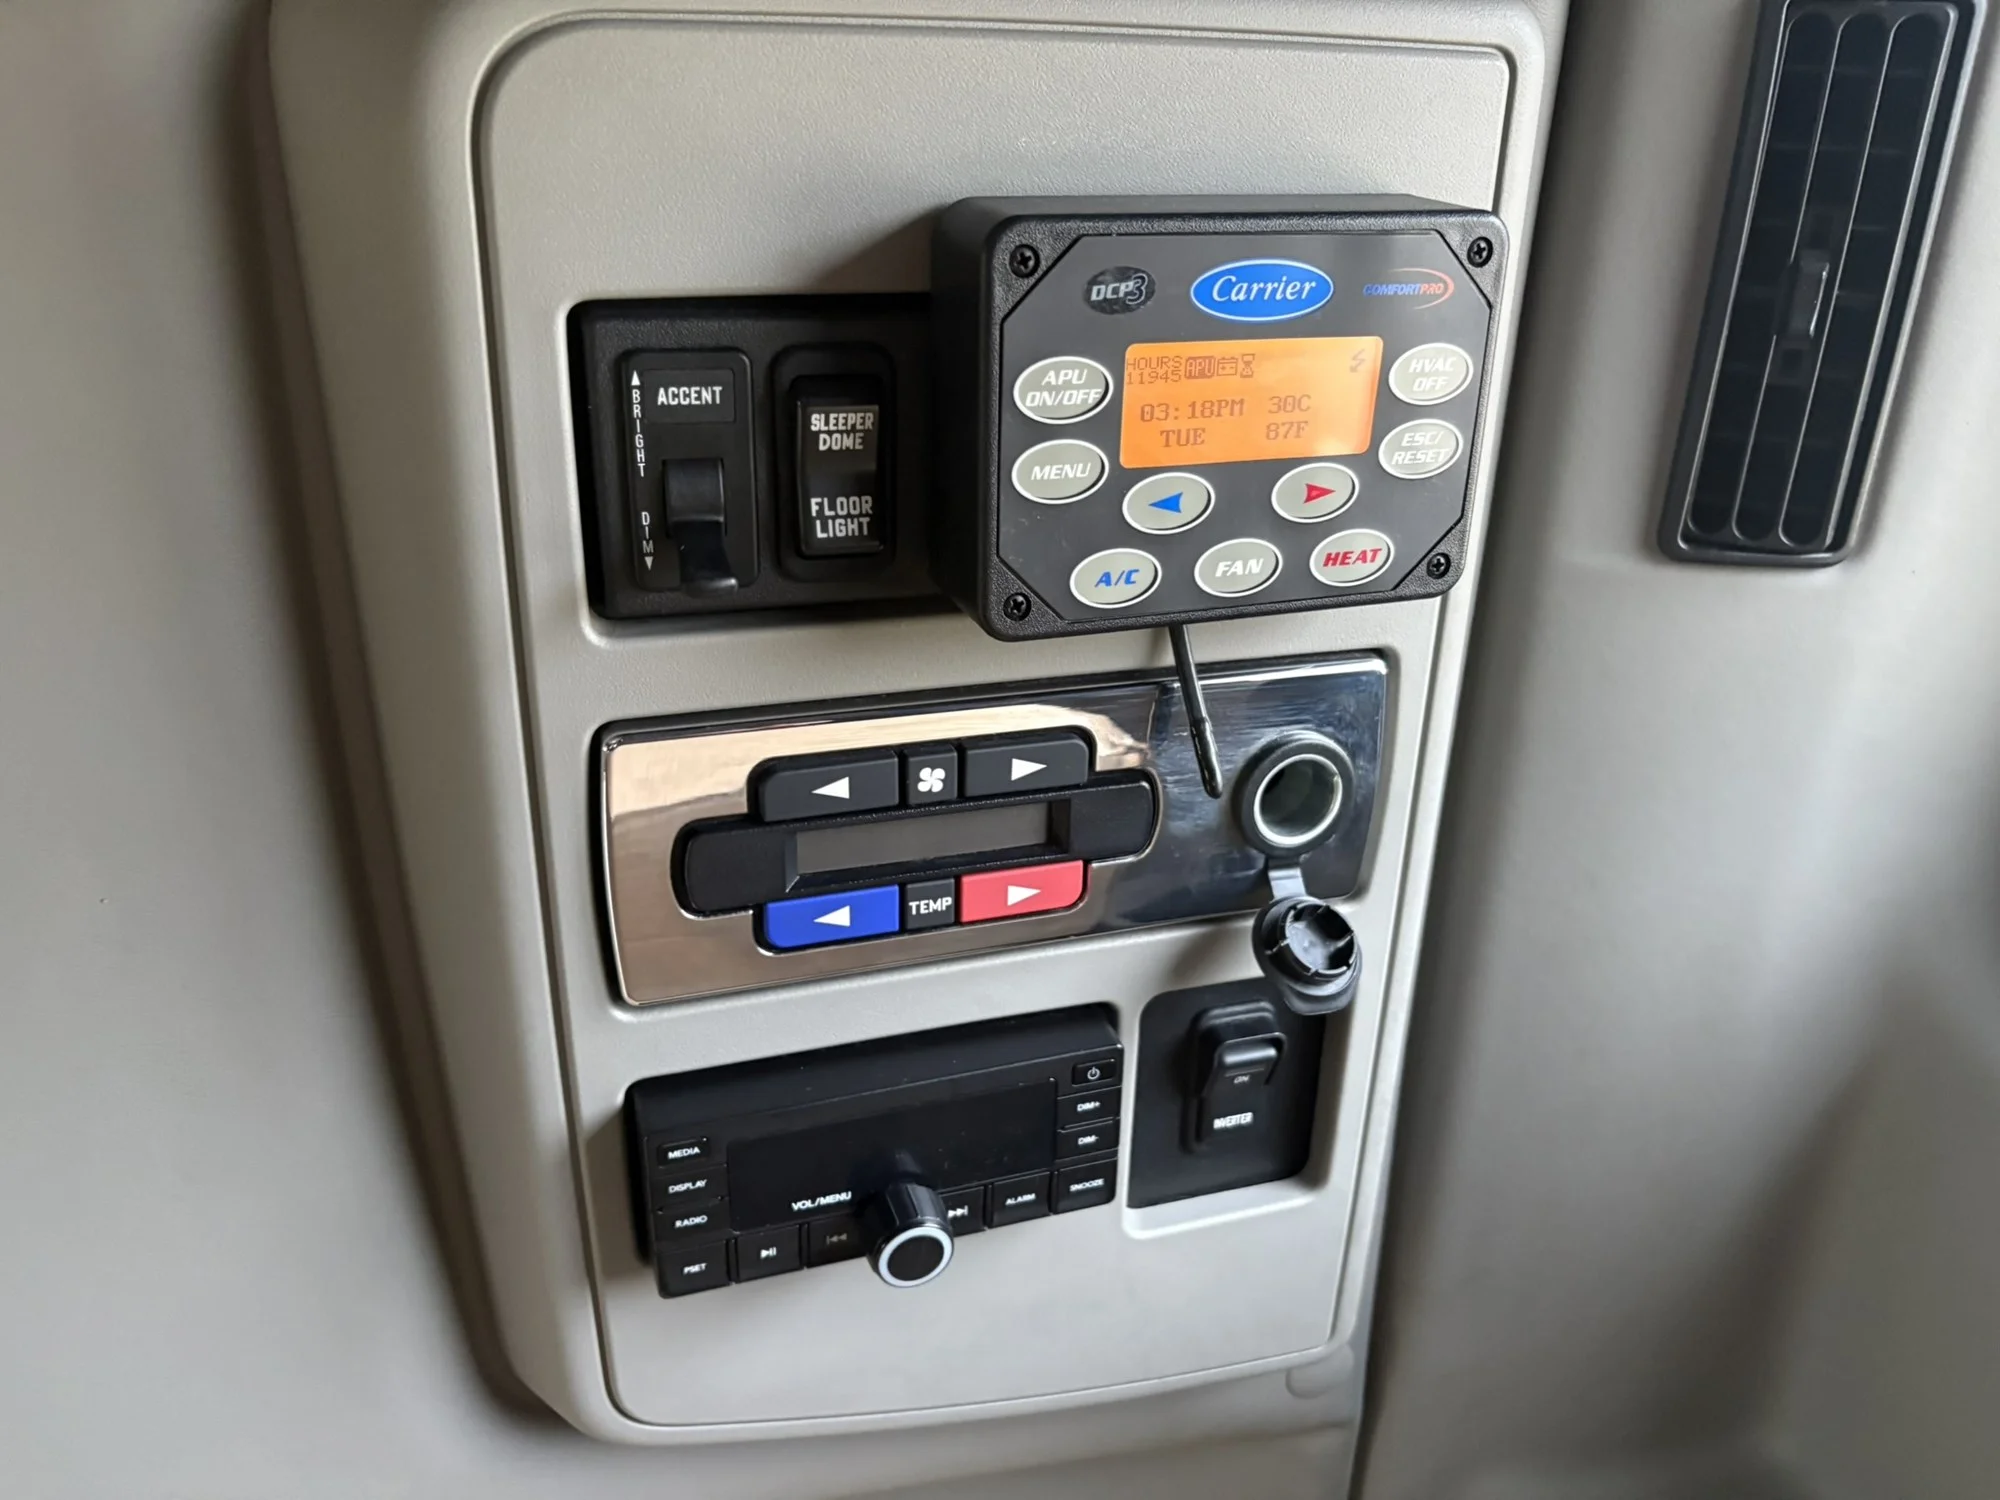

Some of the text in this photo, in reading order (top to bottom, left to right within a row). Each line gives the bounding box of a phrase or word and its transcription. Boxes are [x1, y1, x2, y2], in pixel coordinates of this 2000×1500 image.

[1211, 275, 1317, 304] Carrier
[1126, 356, 1183, 371] HOURS
[1408, 358, 1454, 374] HVAC
[1041, 369, 1087, 386] APU
[1126, 370, 1182, 385] 11945
[1412, 376, 1449, 392] OFF
[657, 386, 723, 406] ACCENT
[1025, 390, 1101, 407] ON/OFF
[1140, 395, 1312, 422] 03:18PM 30C
[810, 412, 874, 432] SLEEPER
[818, 432, 864, 451] DOME
[1160, 421, 1310, 448] TUE 87F
[1401, 432, 1442, 448] ESC/
[1391, 448, 1449, 465] RESET
[1031, 463, 1092, 481] MENU
[810, 496, 873, 517] FLOOR
[816, 517, 871, 539] LIGHT
[1323, 548, 1382, 567] HEAT
[1215, 558, 1263, 576] FAN
[1095, 568, 1140, 587] A/C
[908, 896, 952, 915] TEMP
[1076, 1101, 1100, 1112] DIM+
[1213, 1111, 1254, 1130] INVERTER
[667, 1146, 700, 1159] MEDIA
[668, 1178, 708, 1194] DISPLAY
[1069, 1178, 1105, 1191] SNOOZE
[791, 1191, 852, 1212] VOL/MENU
[1005, 1192, 1036, 1205] ALARM
[674, 1215, 708, 1228] RADIO
[682, 1262, 708, 1275] PSET
